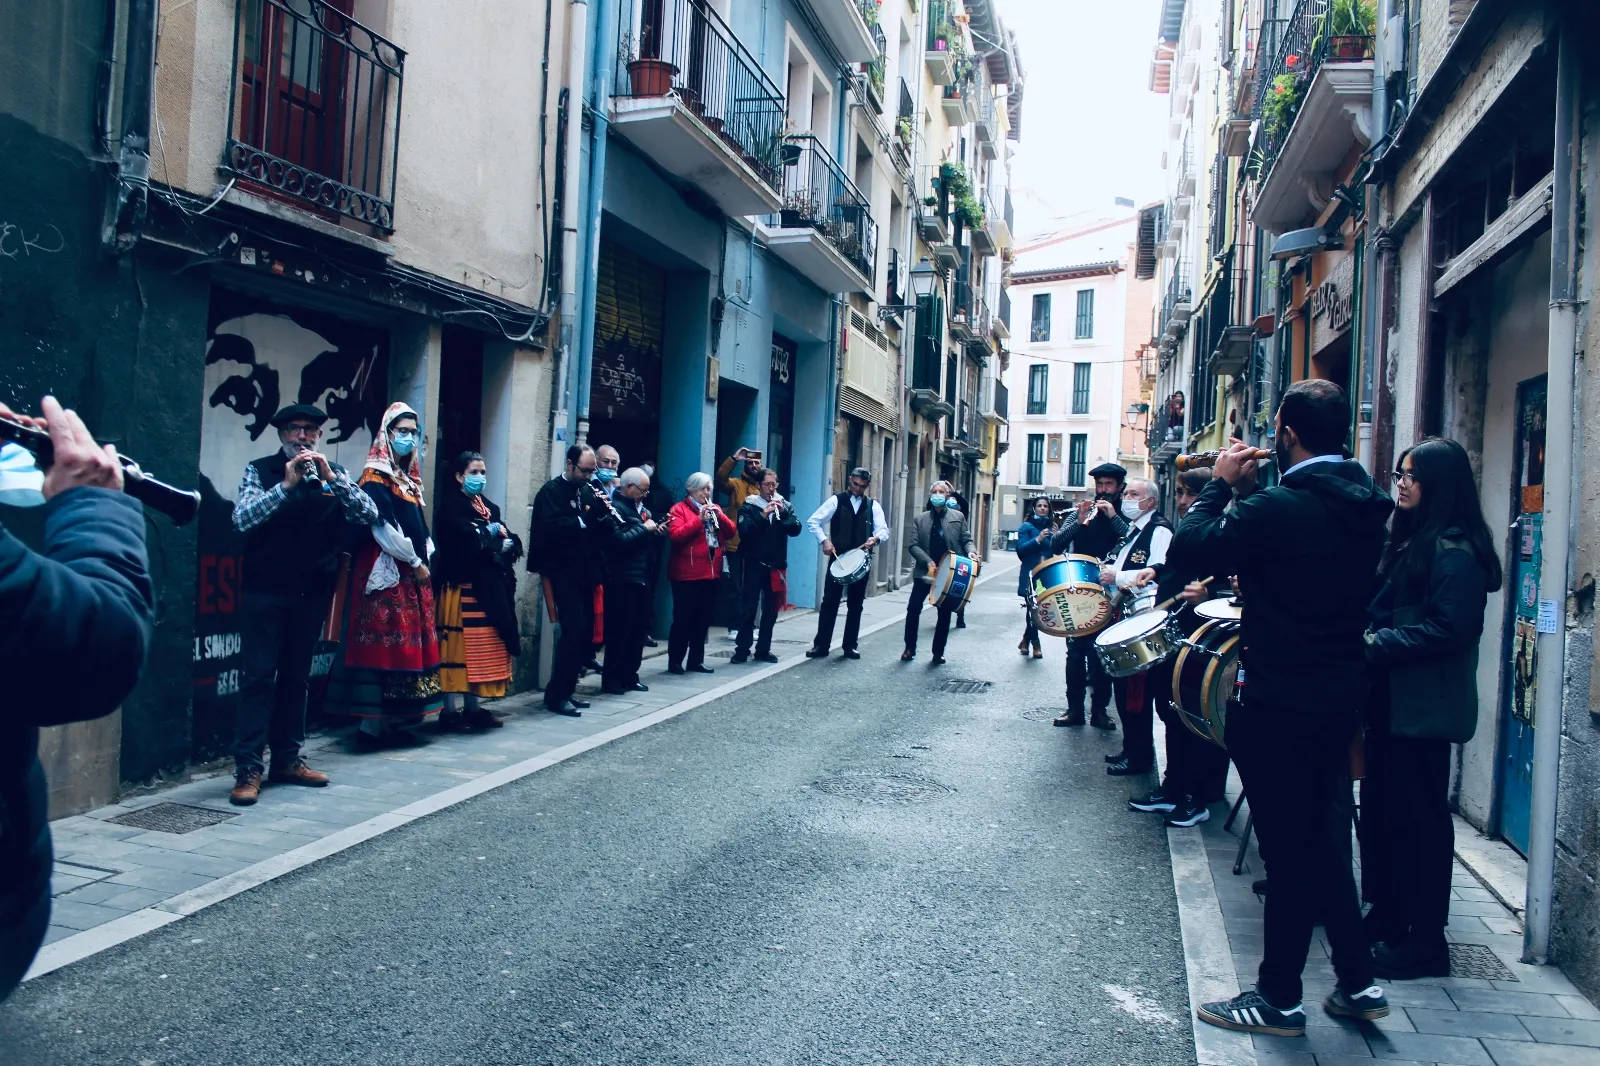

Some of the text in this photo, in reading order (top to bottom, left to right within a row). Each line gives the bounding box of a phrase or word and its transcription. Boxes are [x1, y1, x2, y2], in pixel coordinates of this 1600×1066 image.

[1312, 285, 1326, 318] BAR
[199, 555, 244, 614] ES
[1039, 602, 1056, 628] CASA
